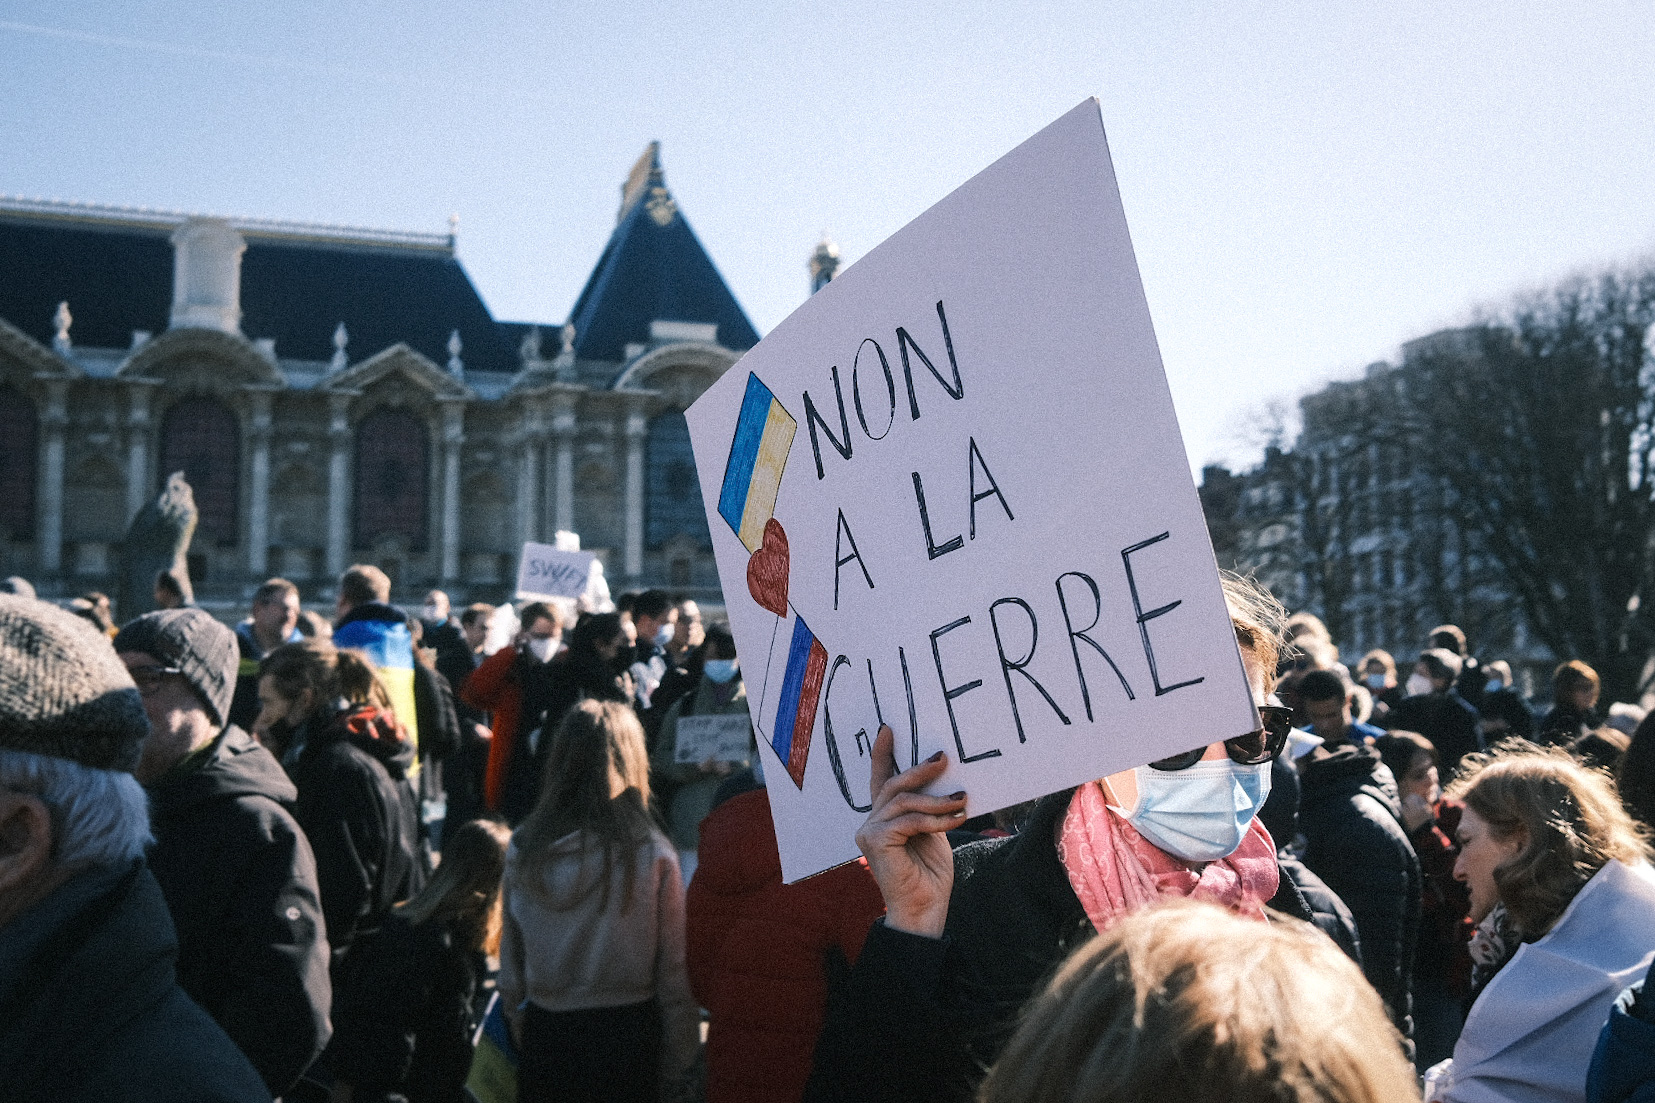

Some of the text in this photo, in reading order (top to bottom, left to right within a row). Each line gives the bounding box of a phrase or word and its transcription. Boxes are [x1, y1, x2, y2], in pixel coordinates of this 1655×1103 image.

[802, 300, 964, 480] NON
[833, 436, 1015, 611] A LA
[824, 531, 1205, 813] GUERRE
